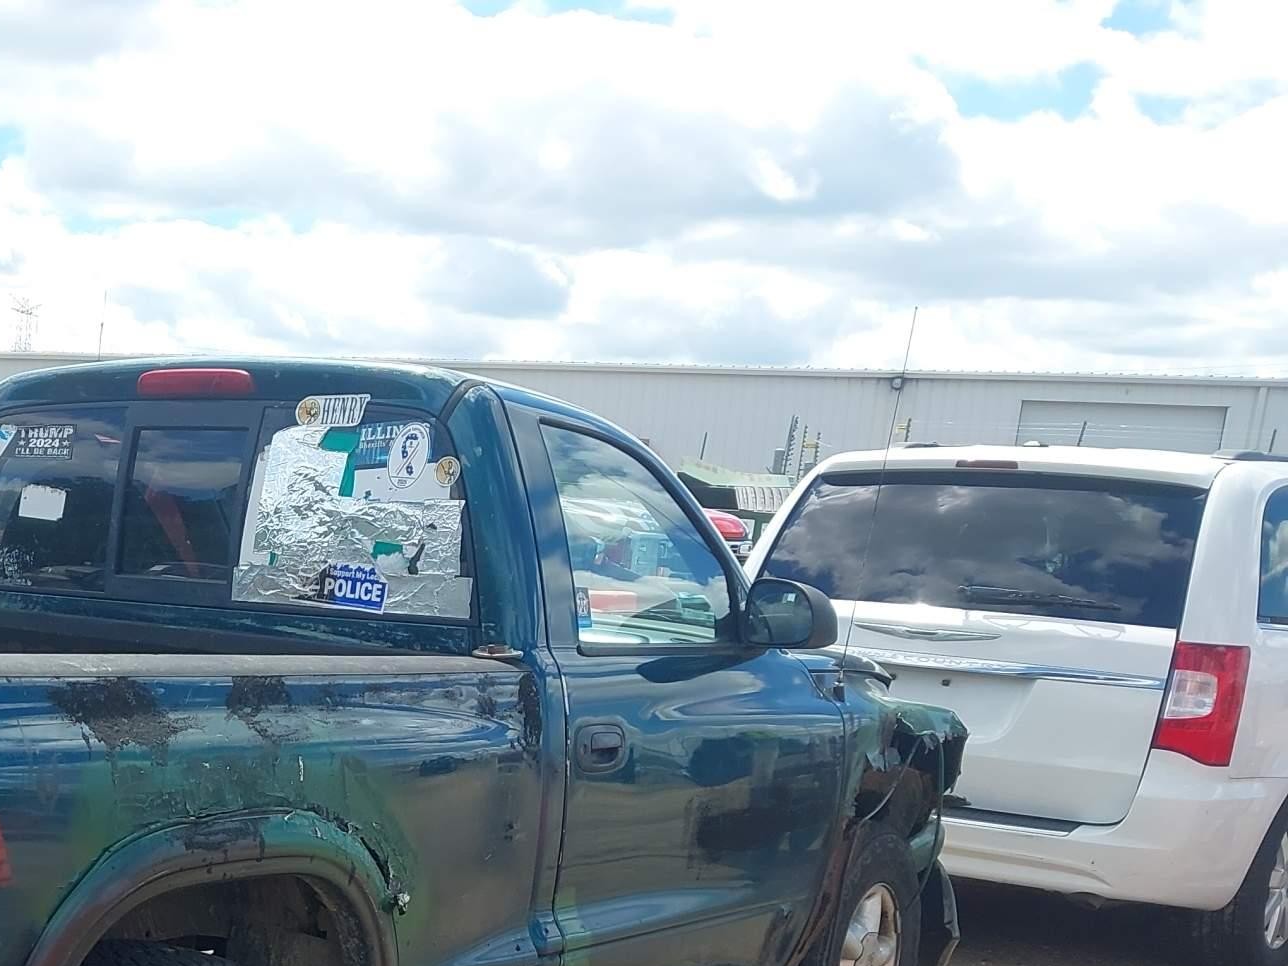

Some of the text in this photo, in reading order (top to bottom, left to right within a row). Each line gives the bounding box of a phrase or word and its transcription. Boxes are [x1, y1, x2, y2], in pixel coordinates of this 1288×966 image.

[320, 396, 369, 425] HENRY
[18, 427, 74, 439] TRUMP
[28, 438, 60, 448] 2024
[33, 447, 45, 455] BE
[46, 448, 70, 456] BACK
[330, 568, 355, 577] Support
[355, 571, 366, 580] My
[324, 577, 382, 602] POLICE
